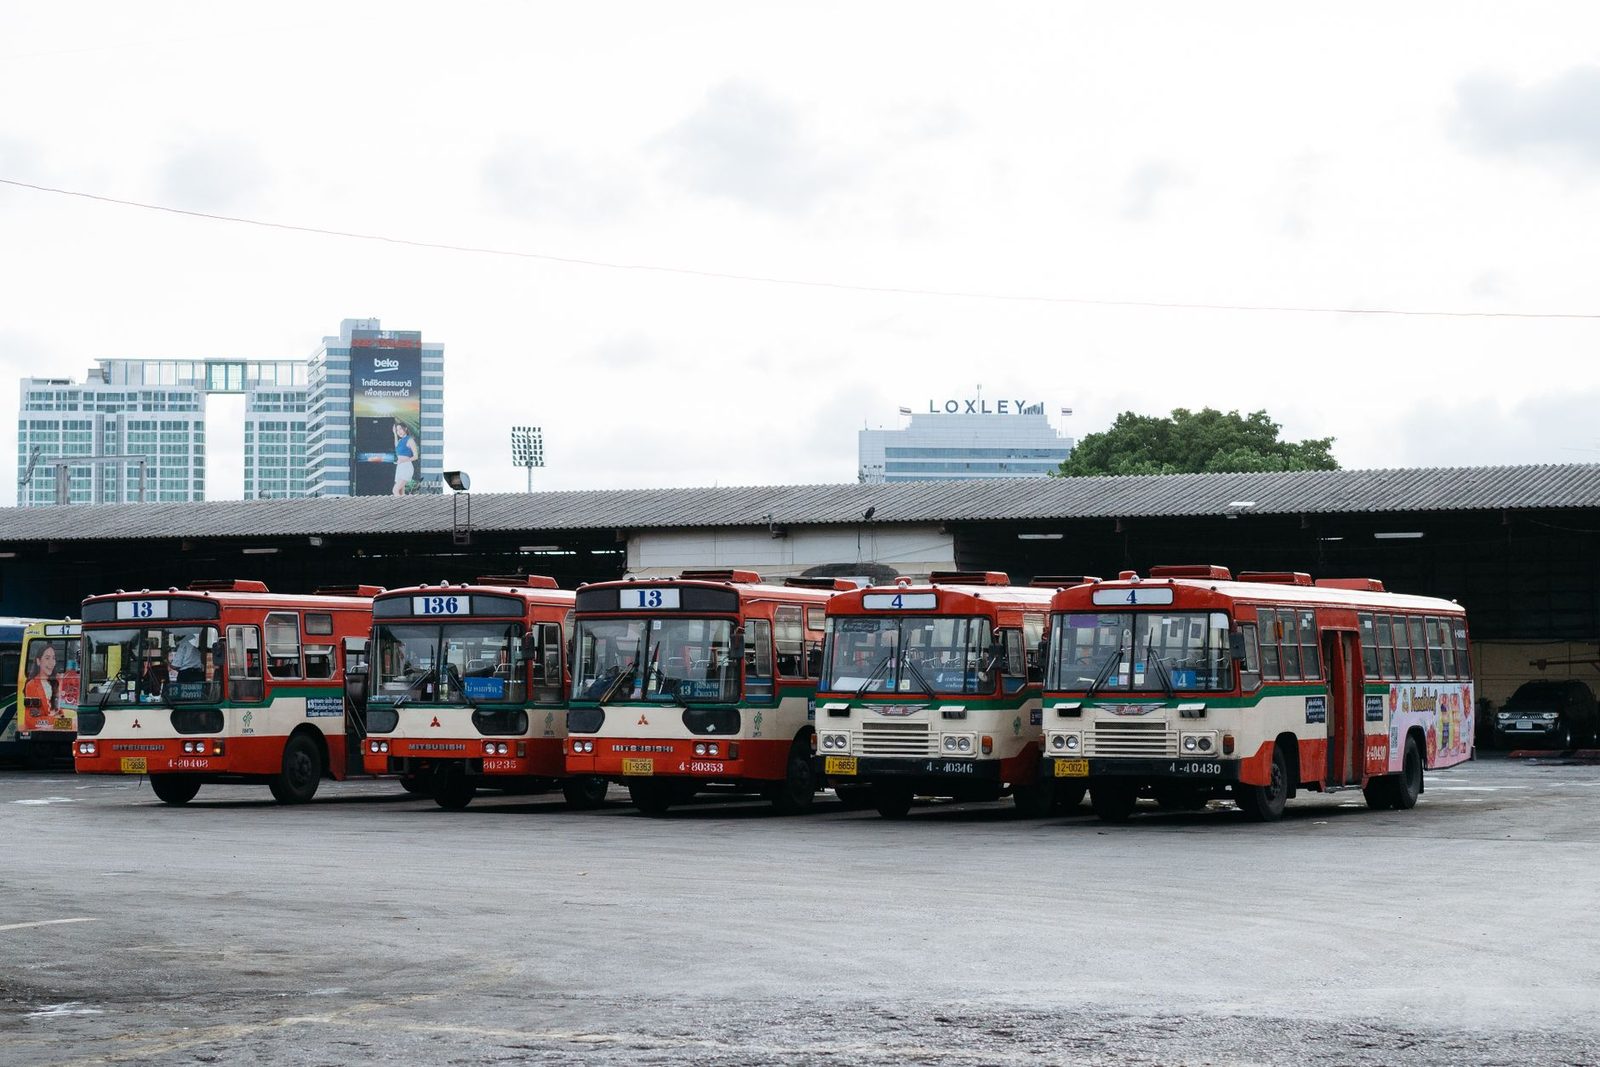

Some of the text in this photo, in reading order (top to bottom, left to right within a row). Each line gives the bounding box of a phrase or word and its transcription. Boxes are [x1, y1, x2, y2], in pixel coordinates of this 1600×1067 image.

[374, 358, 399, 367] beko
[929, 399, 1026, 415] LOXLEY
[637, 590, 662, 608] 13
[891, 594, 903, 609] 4
[1126, 589, 1138, 604] 4
[131, 601, 153, 618] 13
[422, 597, 458, 614] 136
[1177, 672, 1188, 687] 4
[680, 685, 691, 696] 13
[168, 759, 209, 768] 4-80408
[483, 760, 517, 769] 80235
[679, 762, 724, 772] 4-80353
